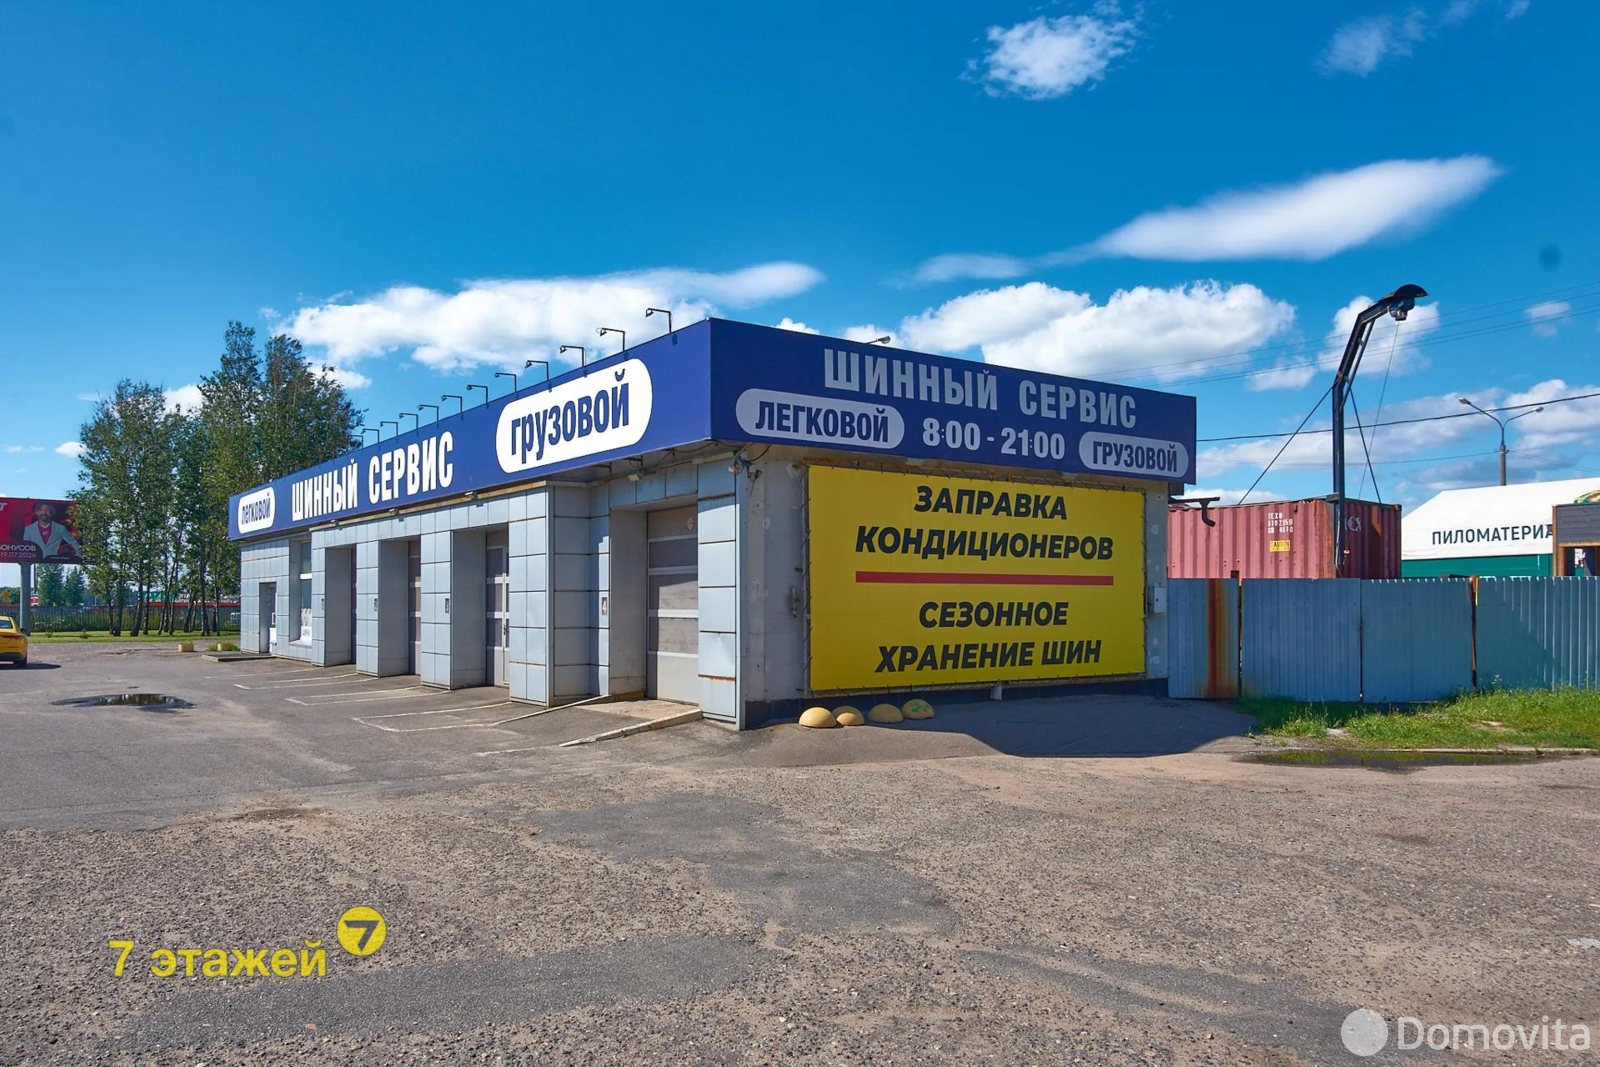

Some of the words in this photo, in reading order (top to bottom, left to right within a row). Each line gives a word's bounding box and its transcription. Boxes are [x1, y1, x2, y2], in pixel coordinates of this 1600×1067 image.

[824, 348, 997, 411] ШИННЫЙ
[1019, 380, 1136, 428] СЕРВИС
[755, 400, 888, 443] ЛЕГКОВОЙ
[922, 417, 981, 450] 8:00
[1001, 427, 1065, 460] 21:00
[1093, 441, 1177, 472] ГРУЗОВОЙ
[291, 458, 358, 521] ШИННЫЙ
[369, 431, 453, 504] СЕРВИС
[914, 485, 1067, 520] ЗАПРАВКА
[855, 525, 1114, 560] КОНДИЦИОНЕРОВ
[918, 601, 1069, 628] СЕЗОННОЕ
[874, 642, 1035, 673] ХРАНЕНИЕ
[1041, 640, 1101, 666] ШИН
